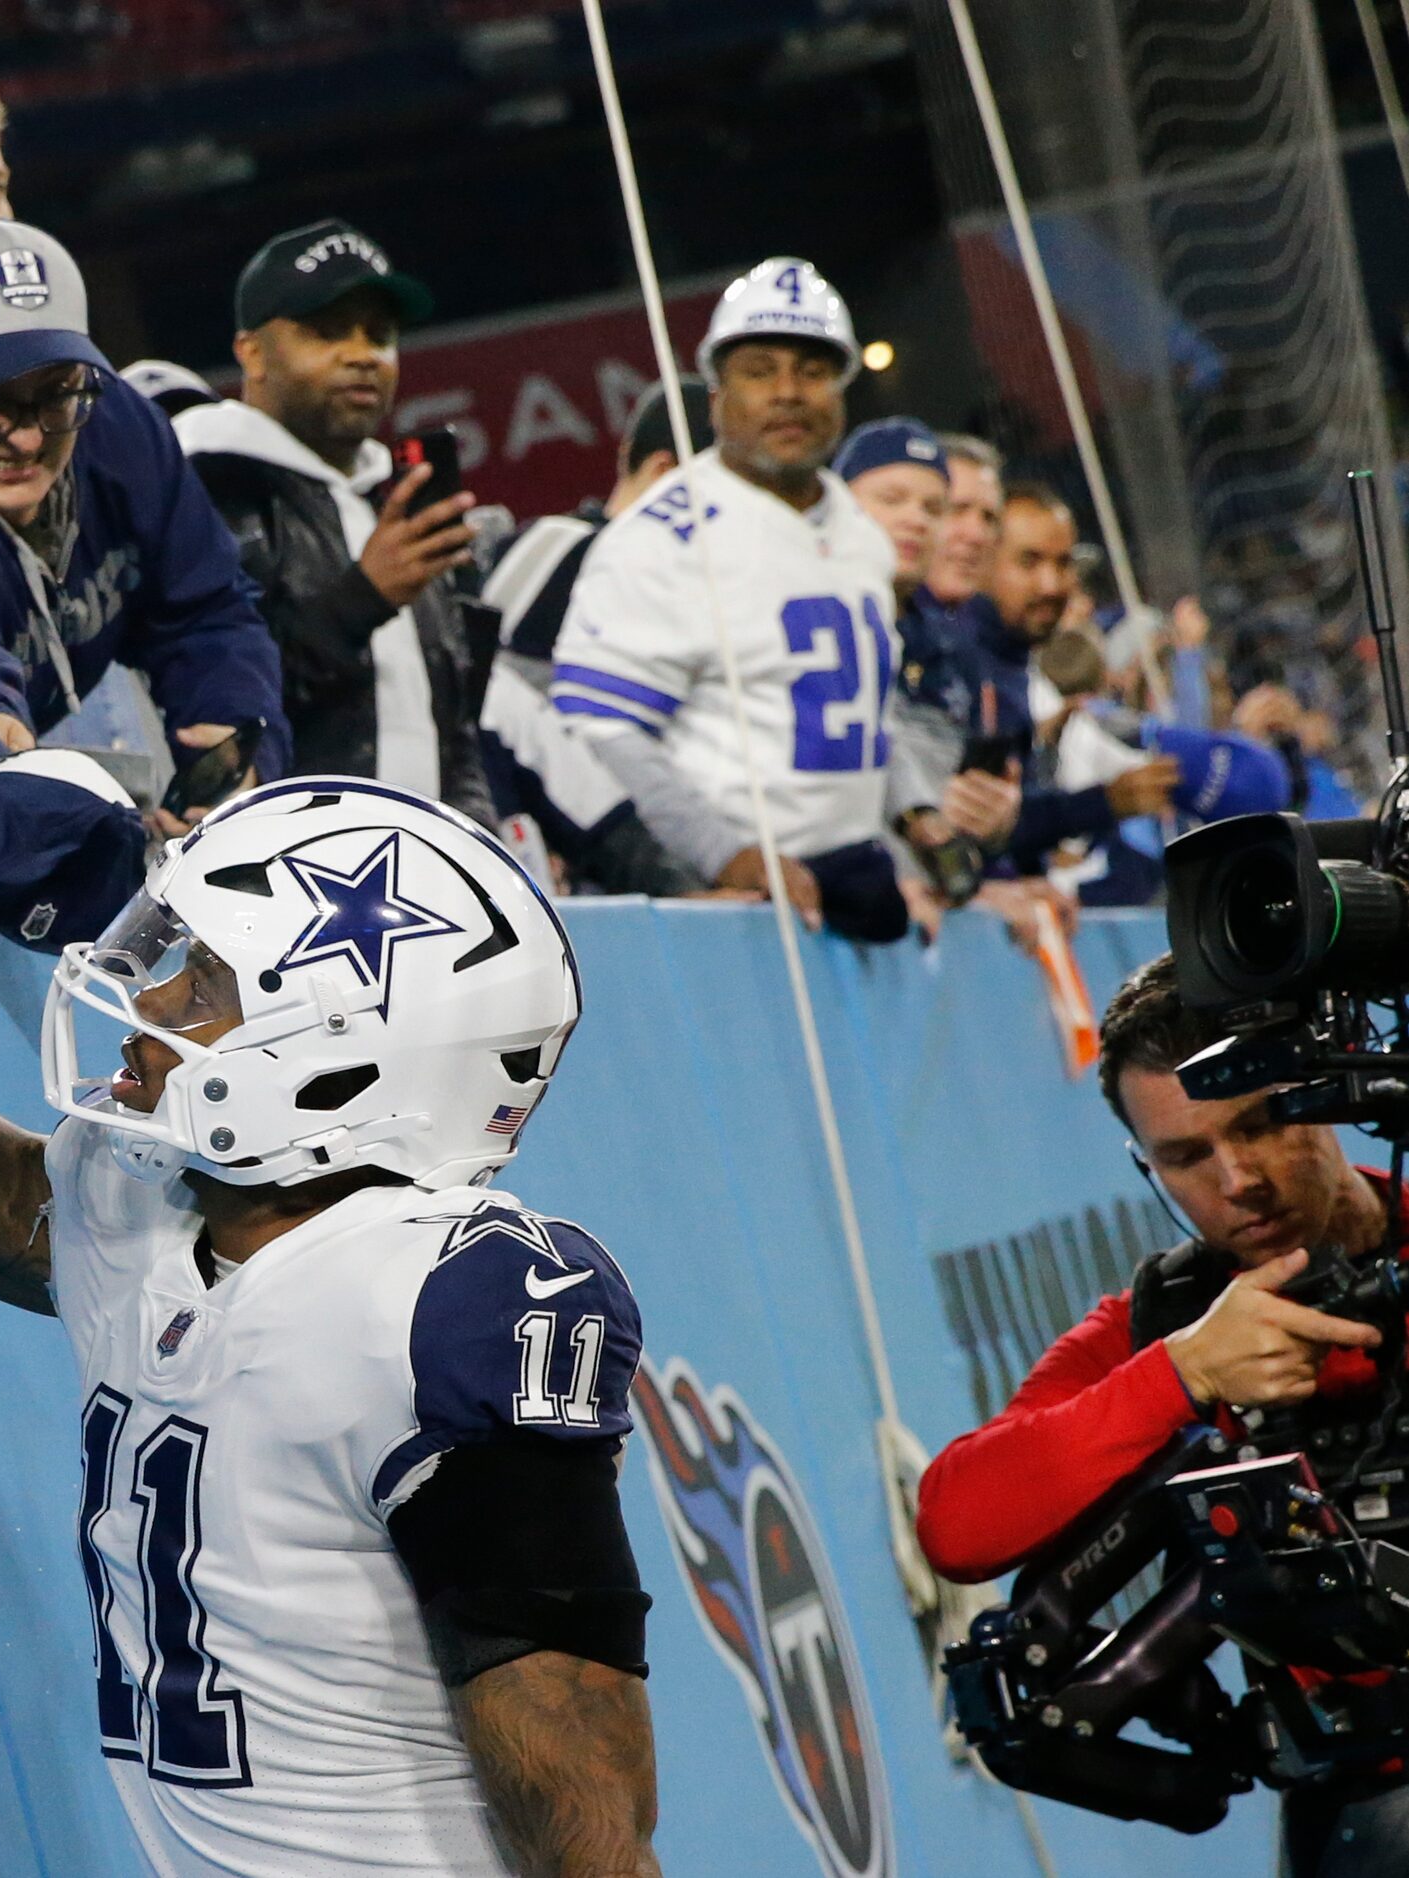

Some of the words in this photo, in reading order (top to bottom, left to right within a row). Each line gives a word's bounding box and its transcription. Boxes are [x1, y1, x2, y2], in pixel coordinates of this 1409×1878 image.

[775, 267, 801, 305] 4
[781, 592, 892, 772] 21
[512, 1310, 605, 1428] 11
[77, 1381, 253, 1789] 11
[1061, 1520, 1127, 1590] PRO
